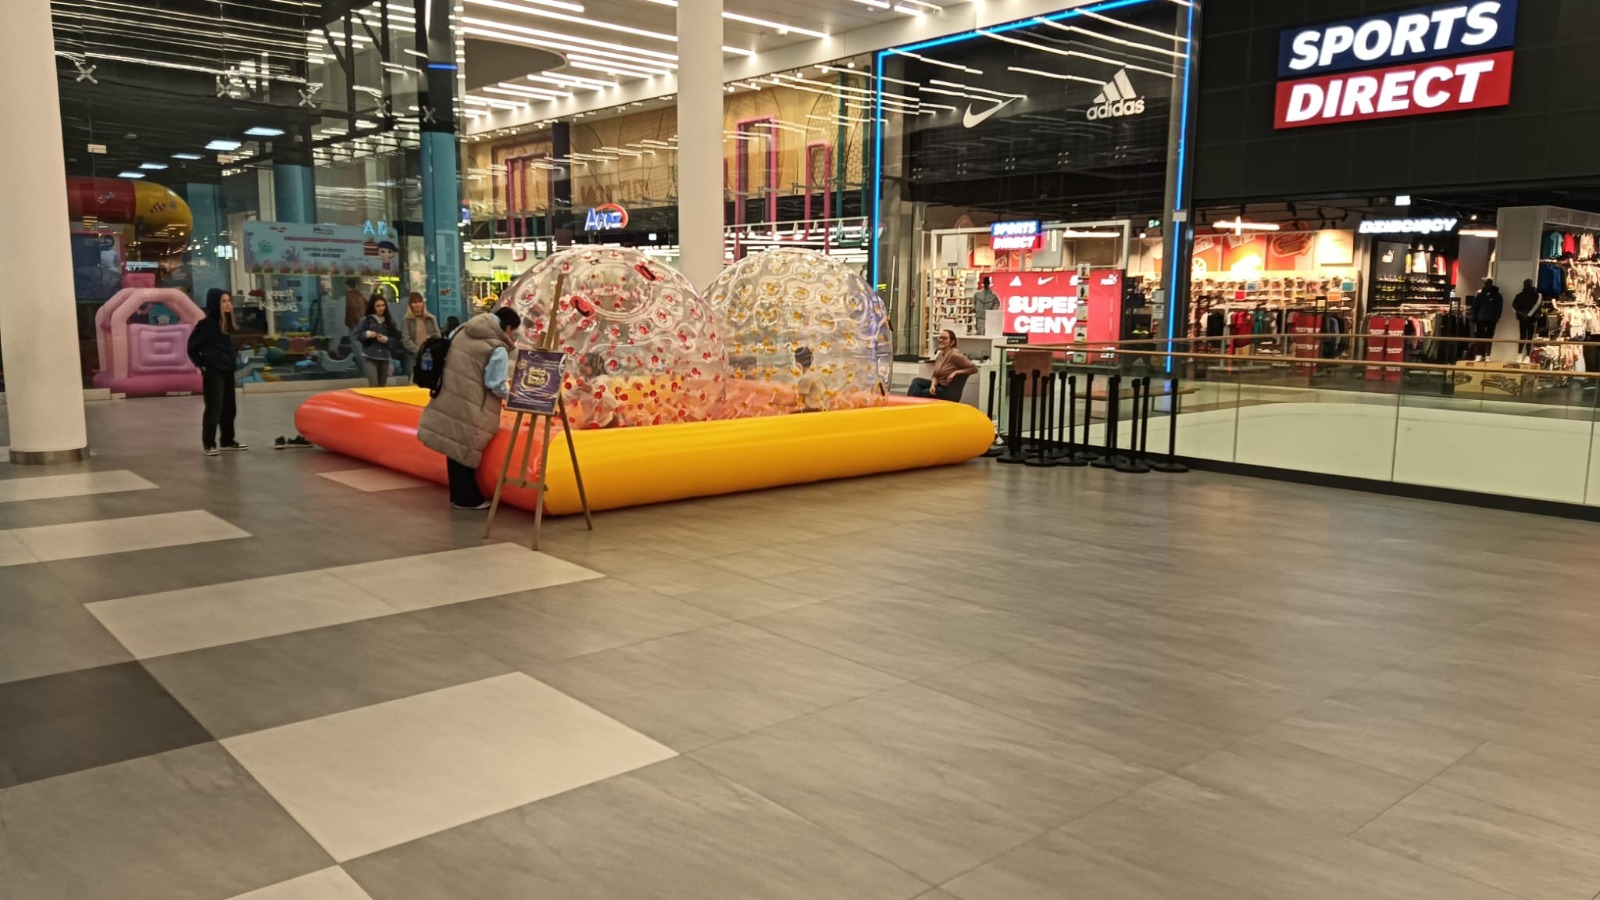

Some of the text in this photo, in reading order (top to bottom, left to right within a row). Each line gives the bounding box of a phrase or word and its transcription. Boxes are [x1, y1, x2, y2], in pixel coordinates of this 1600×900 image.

[1289, 1, 1501, 70] SPORTS
[1285, 60, 1495, 122] DIRECT
[1086, 97, 1145, 119] adidas
[993, 221, 1036, 236] SPORTS
[993, 236, 1035, 249] DIRECT
[1013, 315, 1077, 334] CENY
